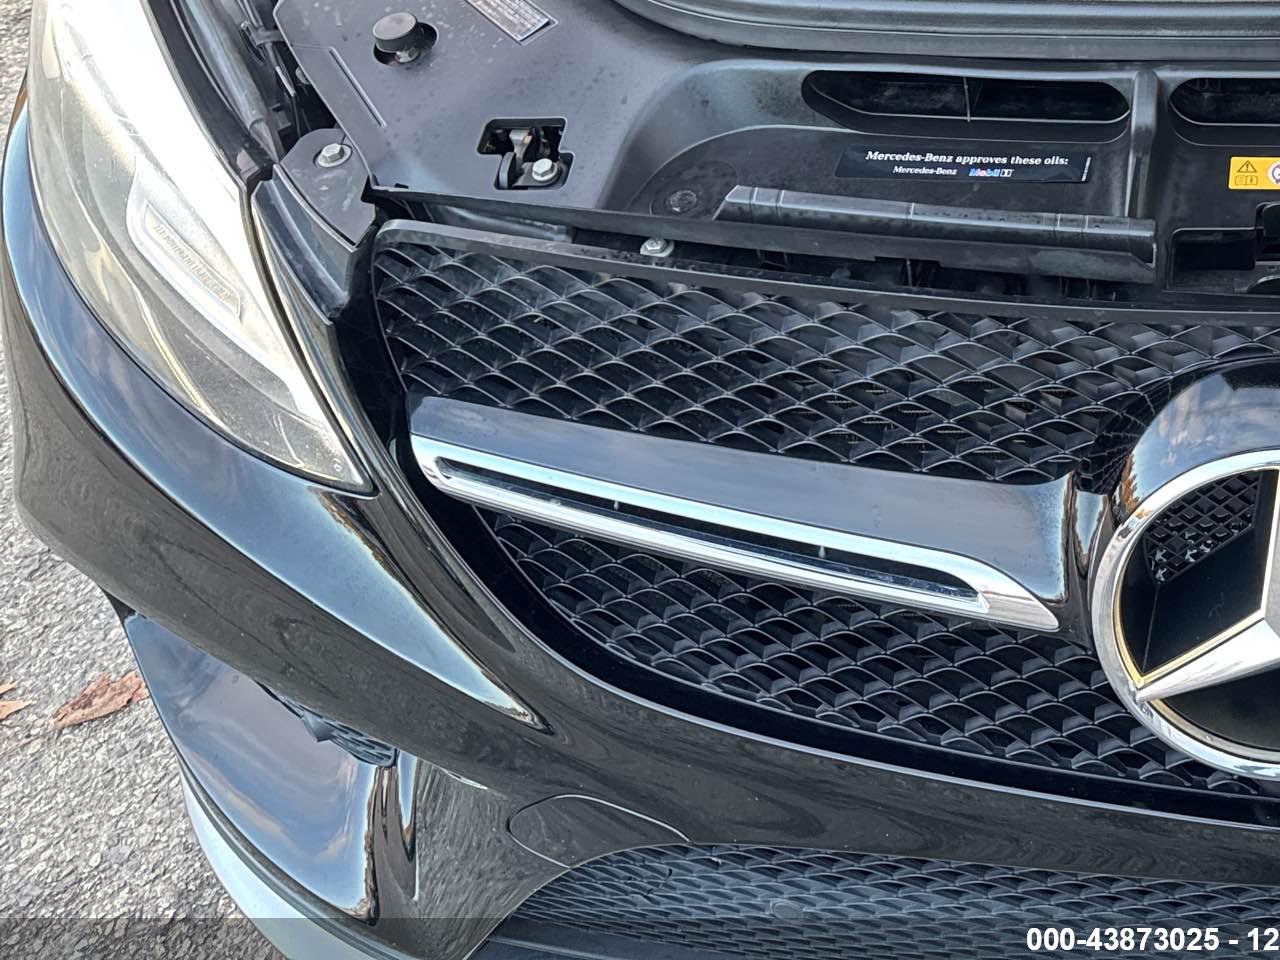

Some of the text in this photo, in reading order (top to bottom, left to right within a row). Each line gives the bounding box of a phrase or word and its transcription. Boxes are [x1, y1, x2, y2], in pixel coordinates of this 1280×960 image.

[865, 150, 953, 163] Mercedes-Benz
[955, 154, 1007, 165] approves
[1010, 155, 1041, 165] these
[893, 165, 958, 175] Mercedes-Benz
